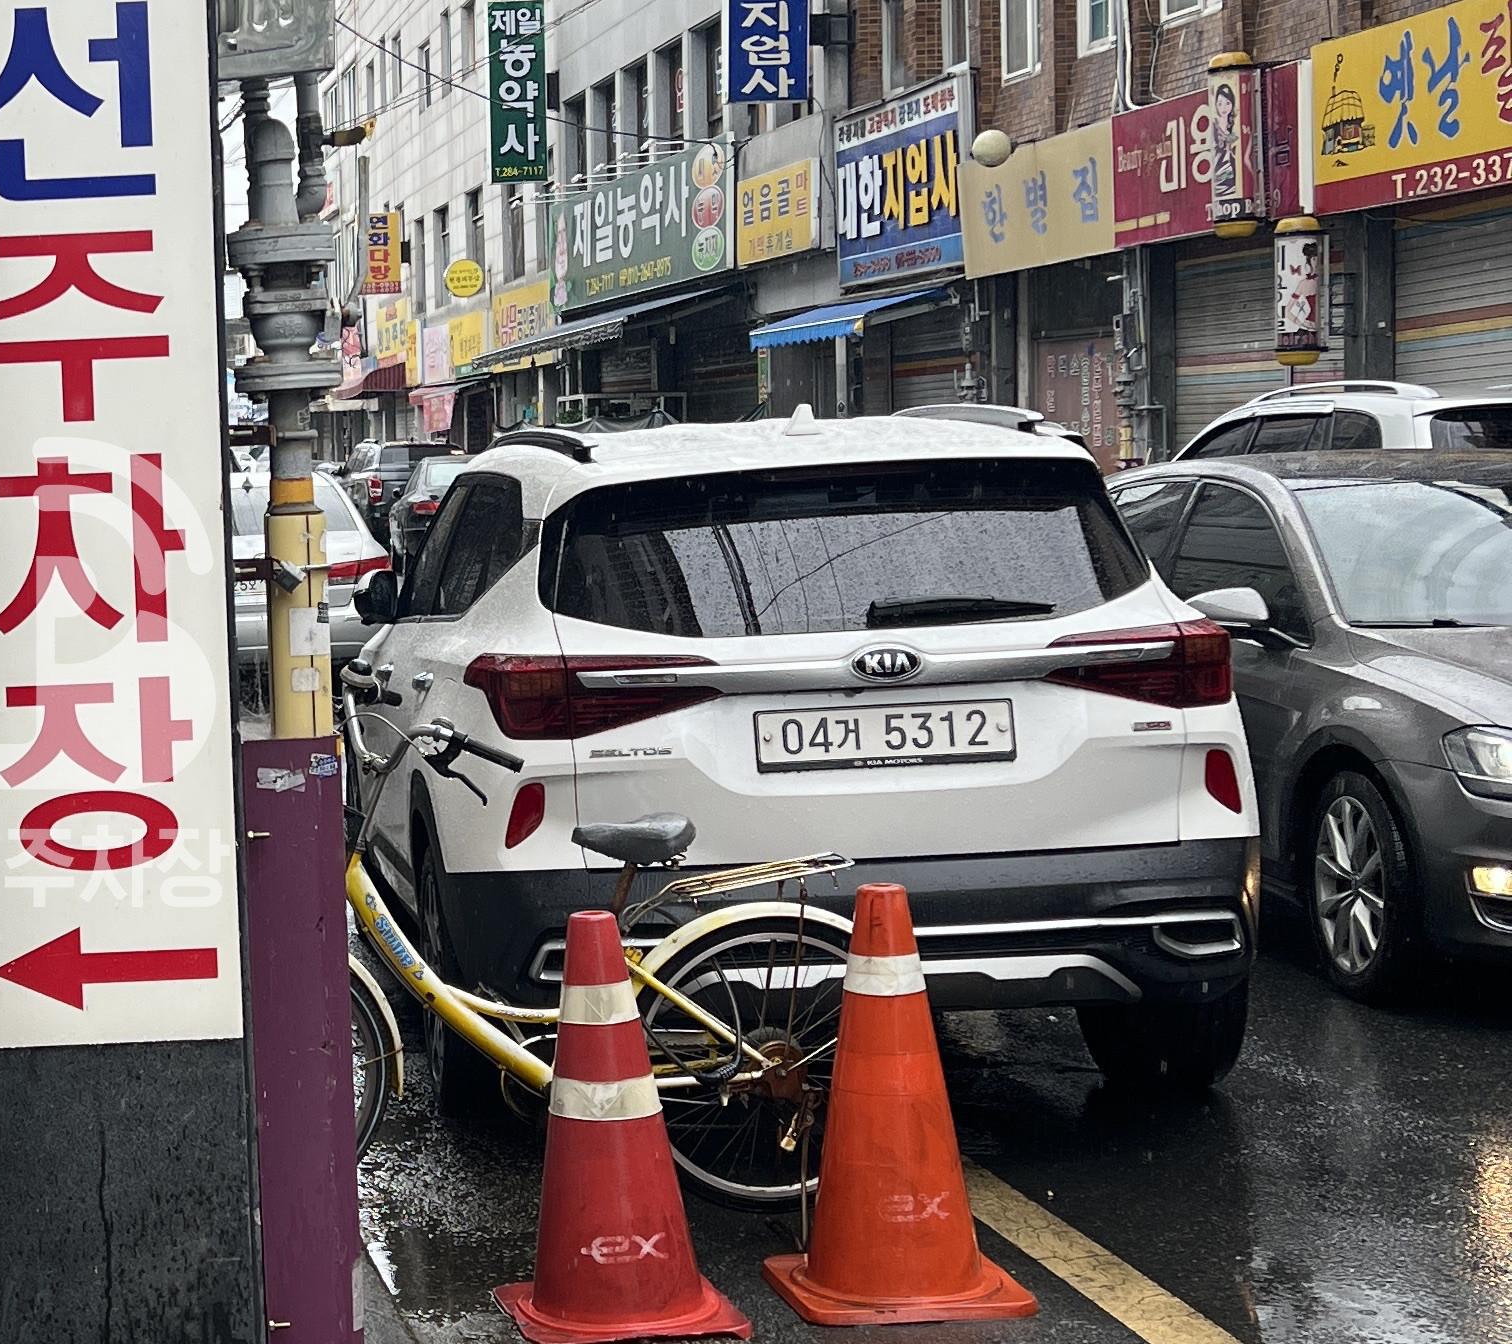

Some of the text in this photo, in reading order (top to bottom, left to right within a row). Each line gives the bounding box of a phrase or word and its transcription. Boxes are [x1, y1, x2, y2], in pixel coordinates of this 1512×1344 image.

[1379, 16, 1471, 149] 옛날
[495, 165, 545, 178] T.284-7117
[742, 169, 809, 227] 얼음골 마트
[838, 129, 958, 240] 대한지업사
[573, 160, 689, 268] 제일농약사
[864, 652, 912, 674] KIA
[884, 709, 990, 752] 5312
